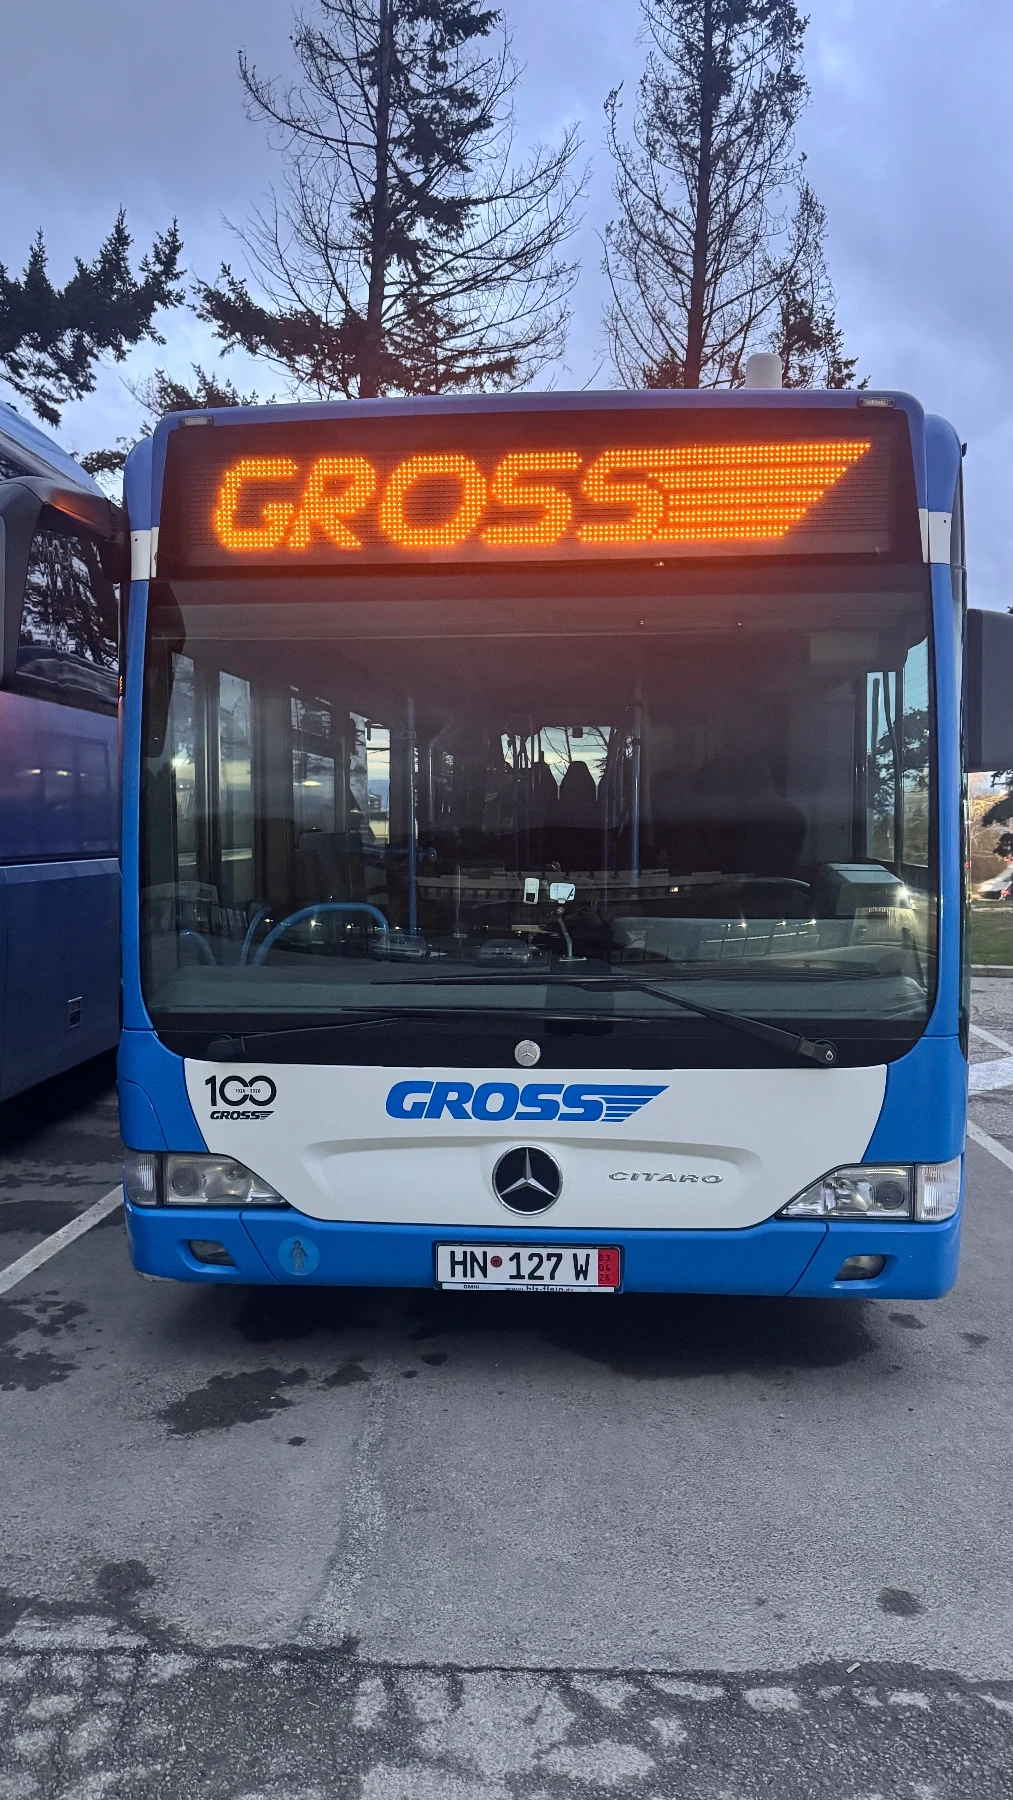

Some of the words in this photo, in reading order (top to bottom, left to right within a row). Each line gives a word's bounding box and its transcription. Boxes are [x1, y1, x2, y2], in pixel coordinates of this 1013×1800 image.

[213, 441, 872, 549] GROSS
[204, 1075, 277, 1106] 100
[385, 1080, 670, 1123] GROSS
[210, 1110, 275, 1120] GROSS
[608, 1171, 723, 1184] CITARO
[598, 1253, 611, 1262] 03
[449, 1250, 488, 1278] HN
[508, 1251, 563, 1280] 127
[572, 1252, 591, 1281] W
[598, 1263, 611, 1272] 04
[599, 1273, 611, 1282] 26
